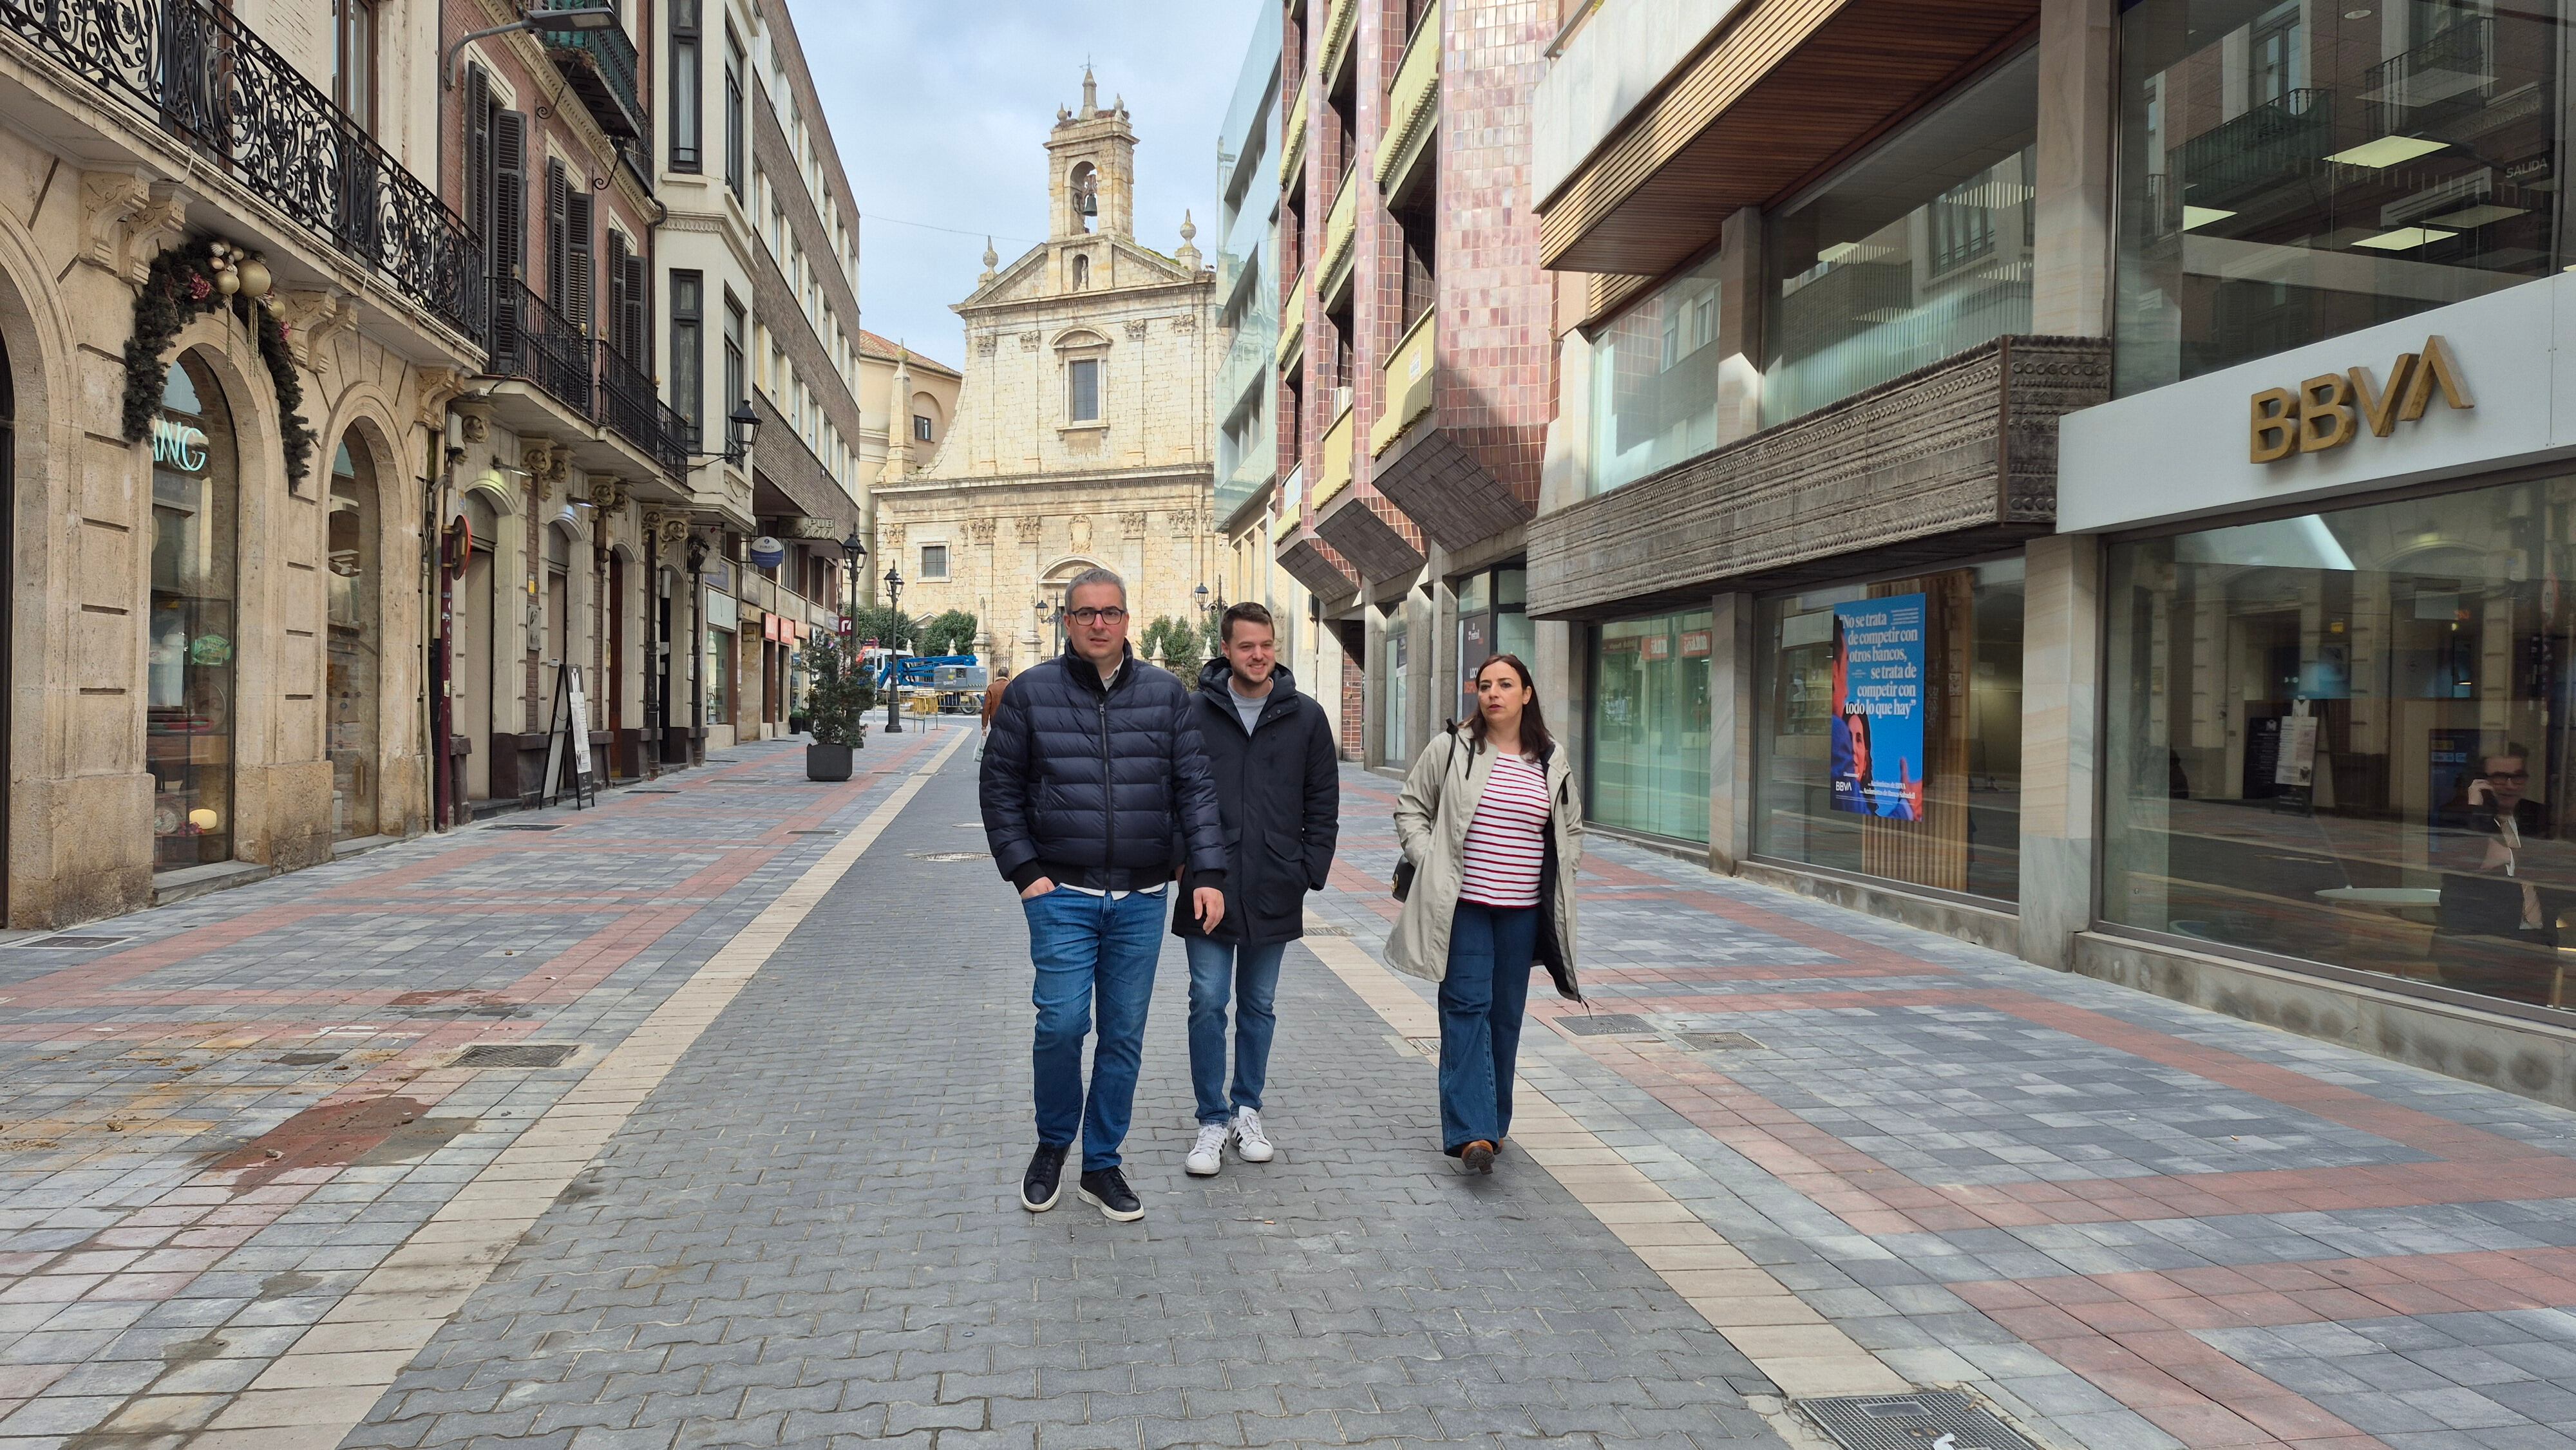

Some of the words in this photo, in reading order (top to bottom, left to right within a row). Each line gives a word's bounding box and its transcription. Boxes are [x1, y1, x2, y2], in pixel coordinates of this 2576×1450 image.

[2505, 157, 2548, 178] SALIDA
[2249, 335, 2475, 464] BBVA
[808, 518, 834, 529] PUB
[1855, 618, 1865, 628] se
[1866, 614, 1887, 627] trata
[1848, 630, 1859, 646] de
[1859, 627, 1900, 648] competir
[1900, 629, 1918, 642] con
[1850, 649, 1871, 663] otros
[1872, 646, 1908, 663] bancos,
[1871, 667, 1880, 679] se
[1881, 664, 1904, 679] trata
[1904, 662, 1917, 679] de
[1857, 681, 1897, 701] competir
[1898, 684, 1916, 697] con
[1845, 700, 1865, 715] todo
[1866, 699, 1875, 715] lo
[1875, 704, 1893, 719] que
[1835, 780, 1852, 791] BBVA
